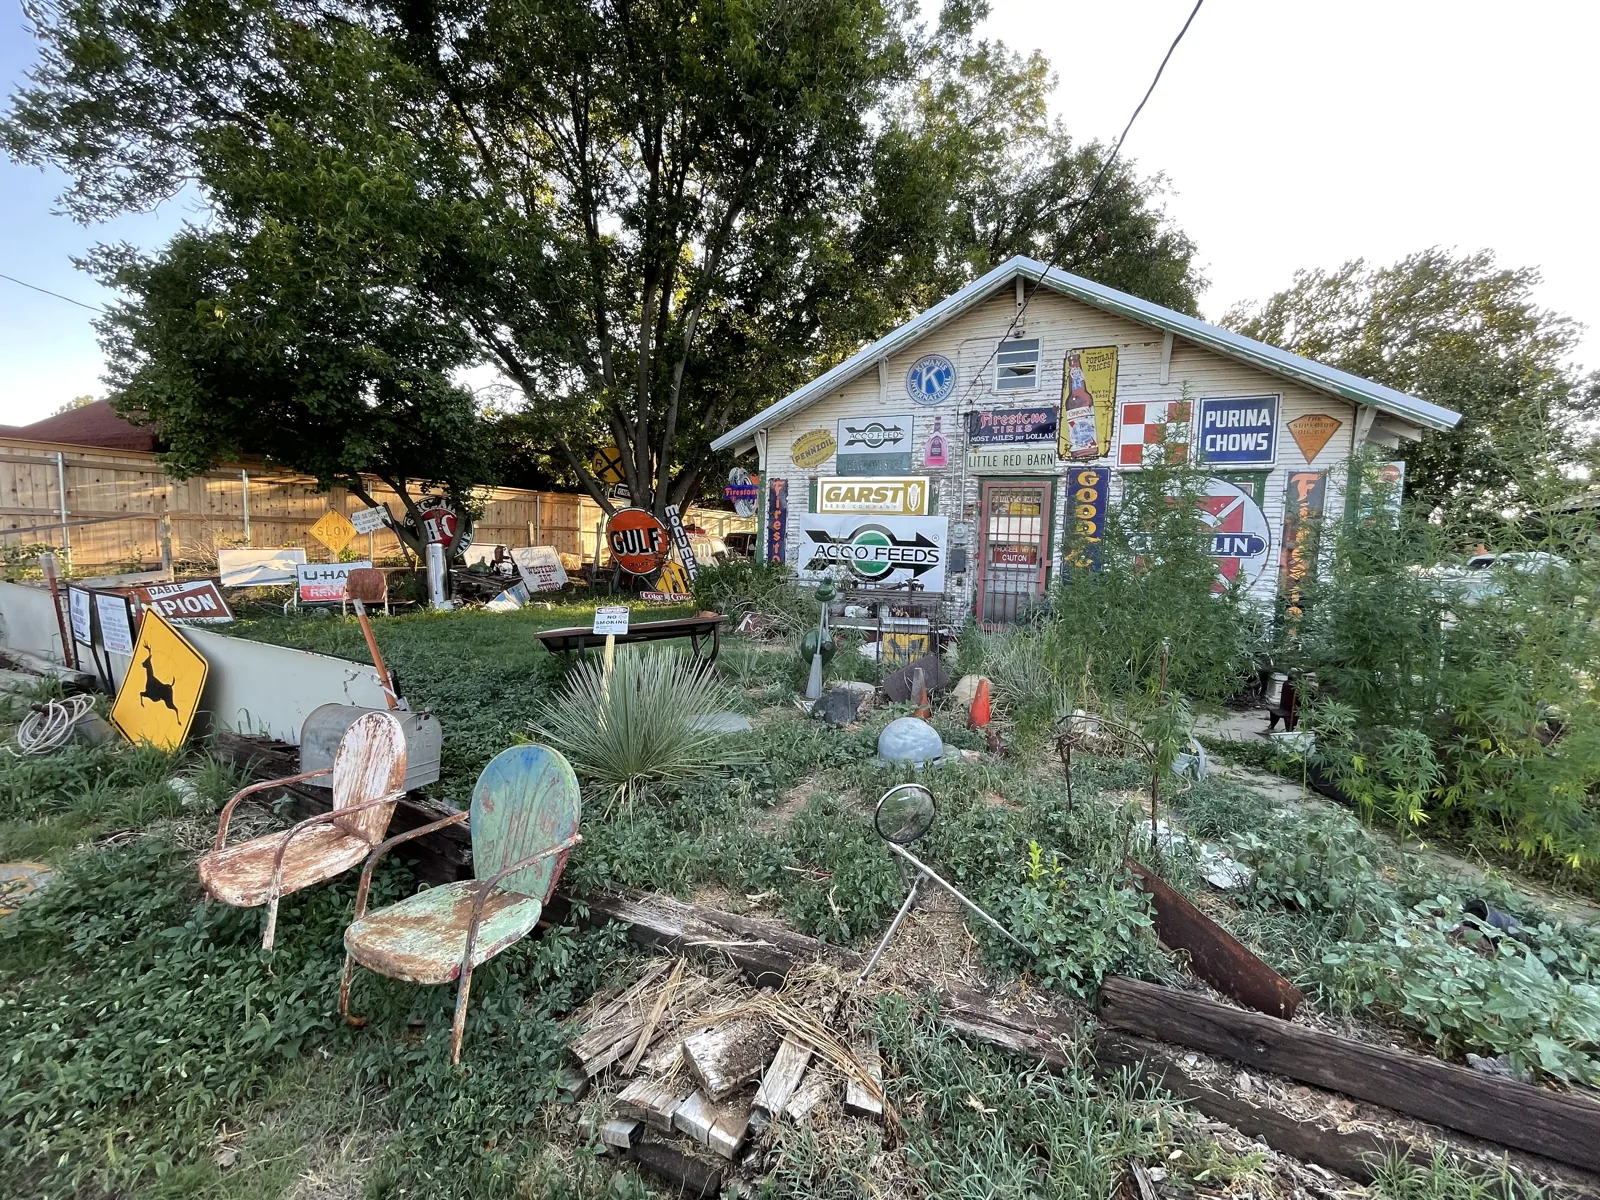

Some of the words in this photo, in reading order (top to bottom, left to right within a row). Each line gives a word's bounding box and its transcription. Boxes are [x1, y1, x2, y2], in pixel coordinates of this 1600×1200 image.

[915, 359, 949, 373] KIWANIS
[1087, 361, 1111, 372] PRICES
[921, 366, 941, 394] K
[910, 375, 952, 401] INTERNATIONAL
[980, 411, 1048, 430] Firestone
[1204, 408, 1272, 428] PURINA
[849, 432, 875, 440] ACCO
[877, 429, 905, 439] FEEDS
[992, 424, 1033, 434] TIRES
[1014, 434, 1025, 442] per
[1205, 432, 1271, 452] CHOWS
[794, 438, 835, 463] PENNZOIL
[968, 455, 998, 468] LITTLE
[1003, 454, 1022, 467] RED
[1027, 453, 1054, 466] BARN
[825, 486, 904, 503] GARST
[772, 480, 786, 563] Firesto
[317, 526, 351, 537] SLOW
[610, 527, 664, 555] GULF
[814, 544, 869, 560] ACCO
[874, 547, 940, 564] FEEDS
[1001, 554, 1028, 562] CAUTON
[303, 569, 350, 581] U-HA
[524, 563, 558, 575] WESTERN
[538, 573, 554, 583] ART
[642, 592, 663, 600] Coke
